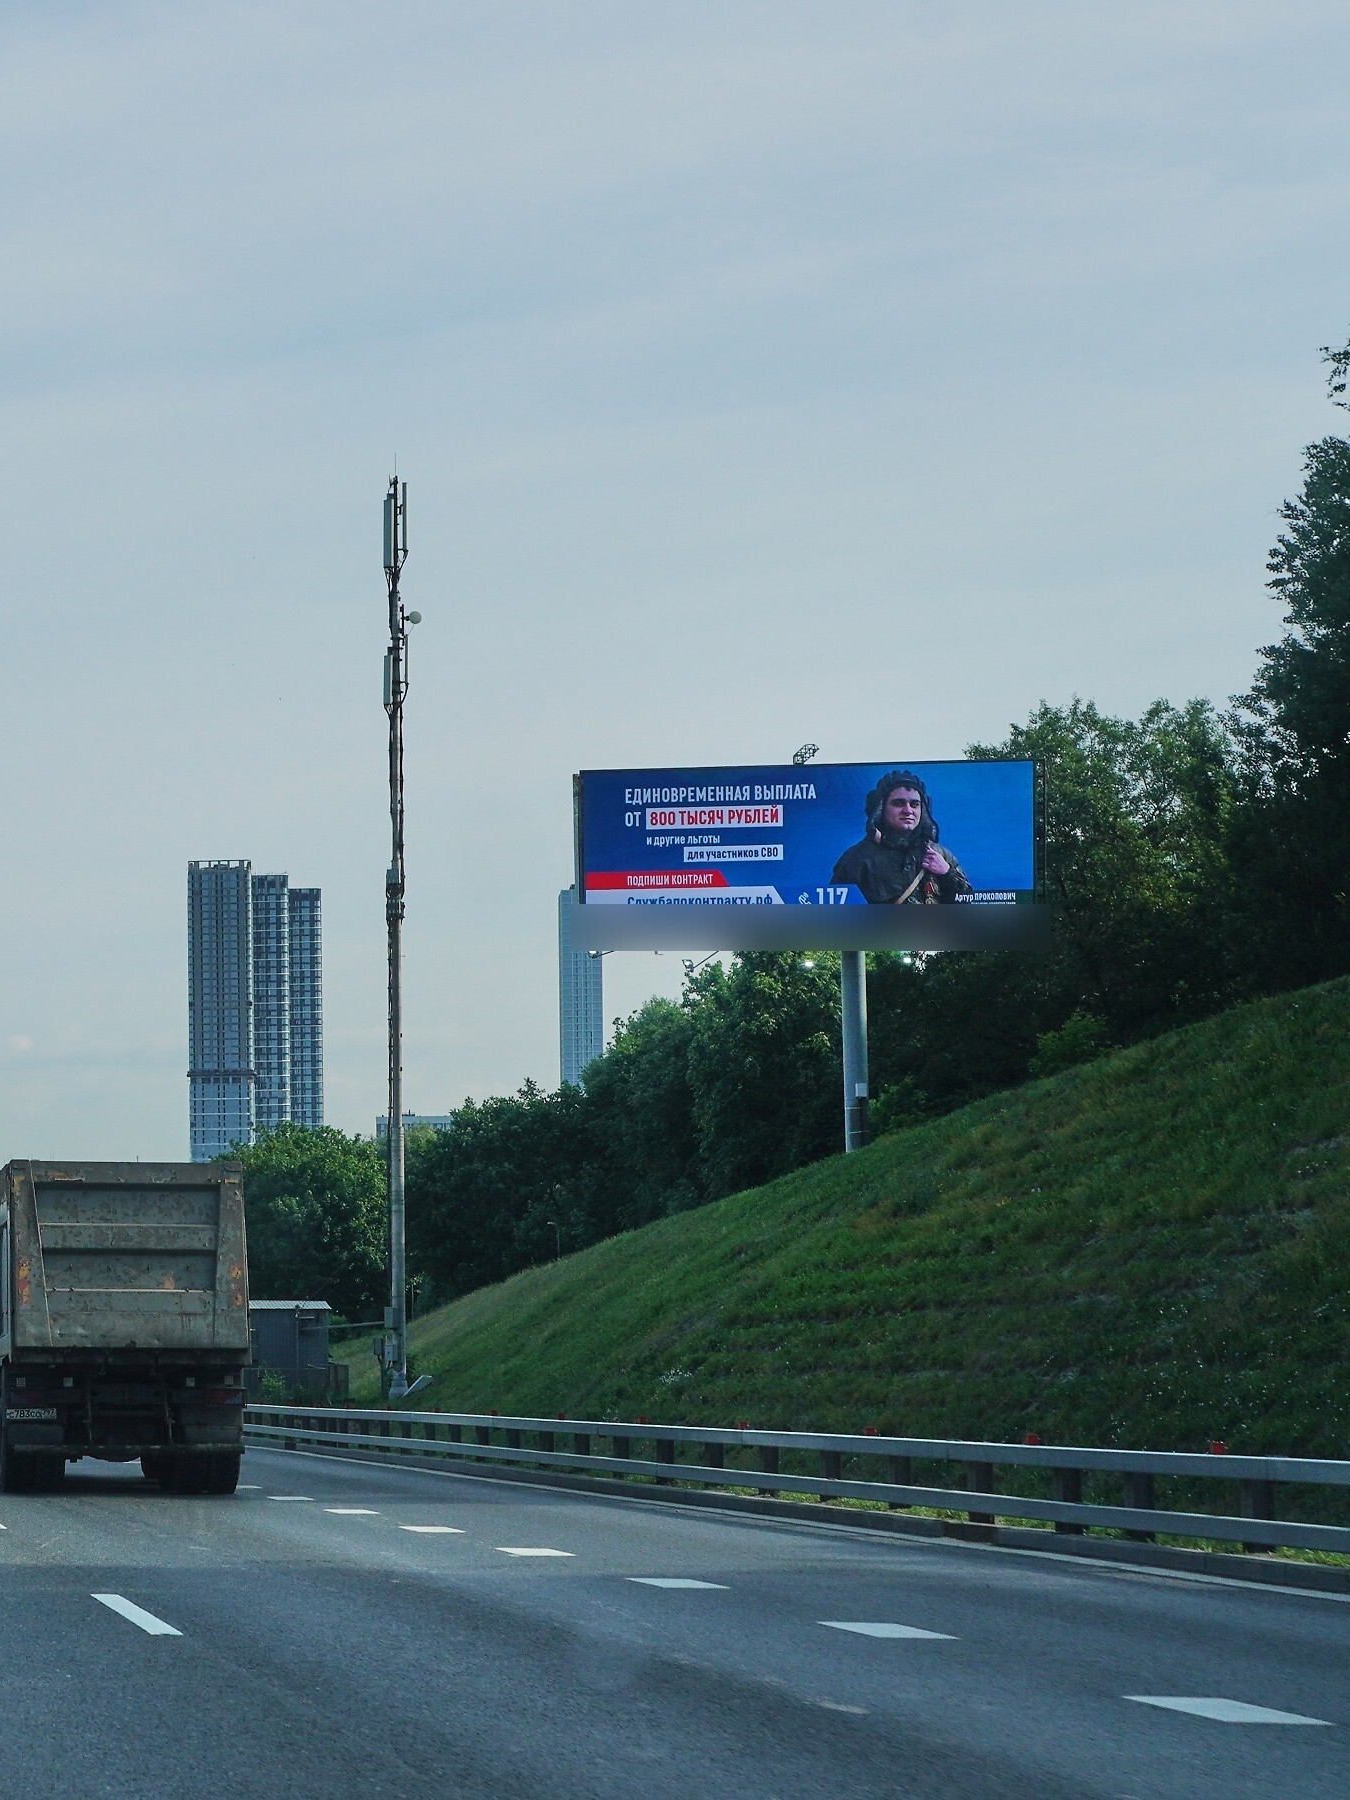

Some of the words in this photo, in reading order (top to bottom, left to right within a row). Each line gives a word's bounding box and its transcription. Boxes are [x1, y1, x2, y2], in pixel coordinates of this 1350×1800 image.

[625, 785, 750, 805] ЕДИНОВРЕМЕННАЯ
[754, 783, 817, 801] ВЫПЛАТА
[625, 811, 641, 827] ОТ
[650, 811, 676, 826] 800
[679, 809, 724, 826] ТЫСЯЧ
[728, 805, 779, 824] РУБЛЕЙ
[646, 836, 652, 845] и
[653, 836, 686, 847] другие
[687, 834, 720, 845] льготы
[687, 850, 705, 861] для
[705, 848, 759, 861] участников
[761, 847, 778, 858] СВО
[627, 874, 669, 887] ПОДПИШИ
[671, 873, 714, 885] КОНТРАКТ
[816, 887, 848, 904] 117
[954, 892, 973, 902] Артур
[974, 892, 1016, 901] ПРОКОПОВИЧ
